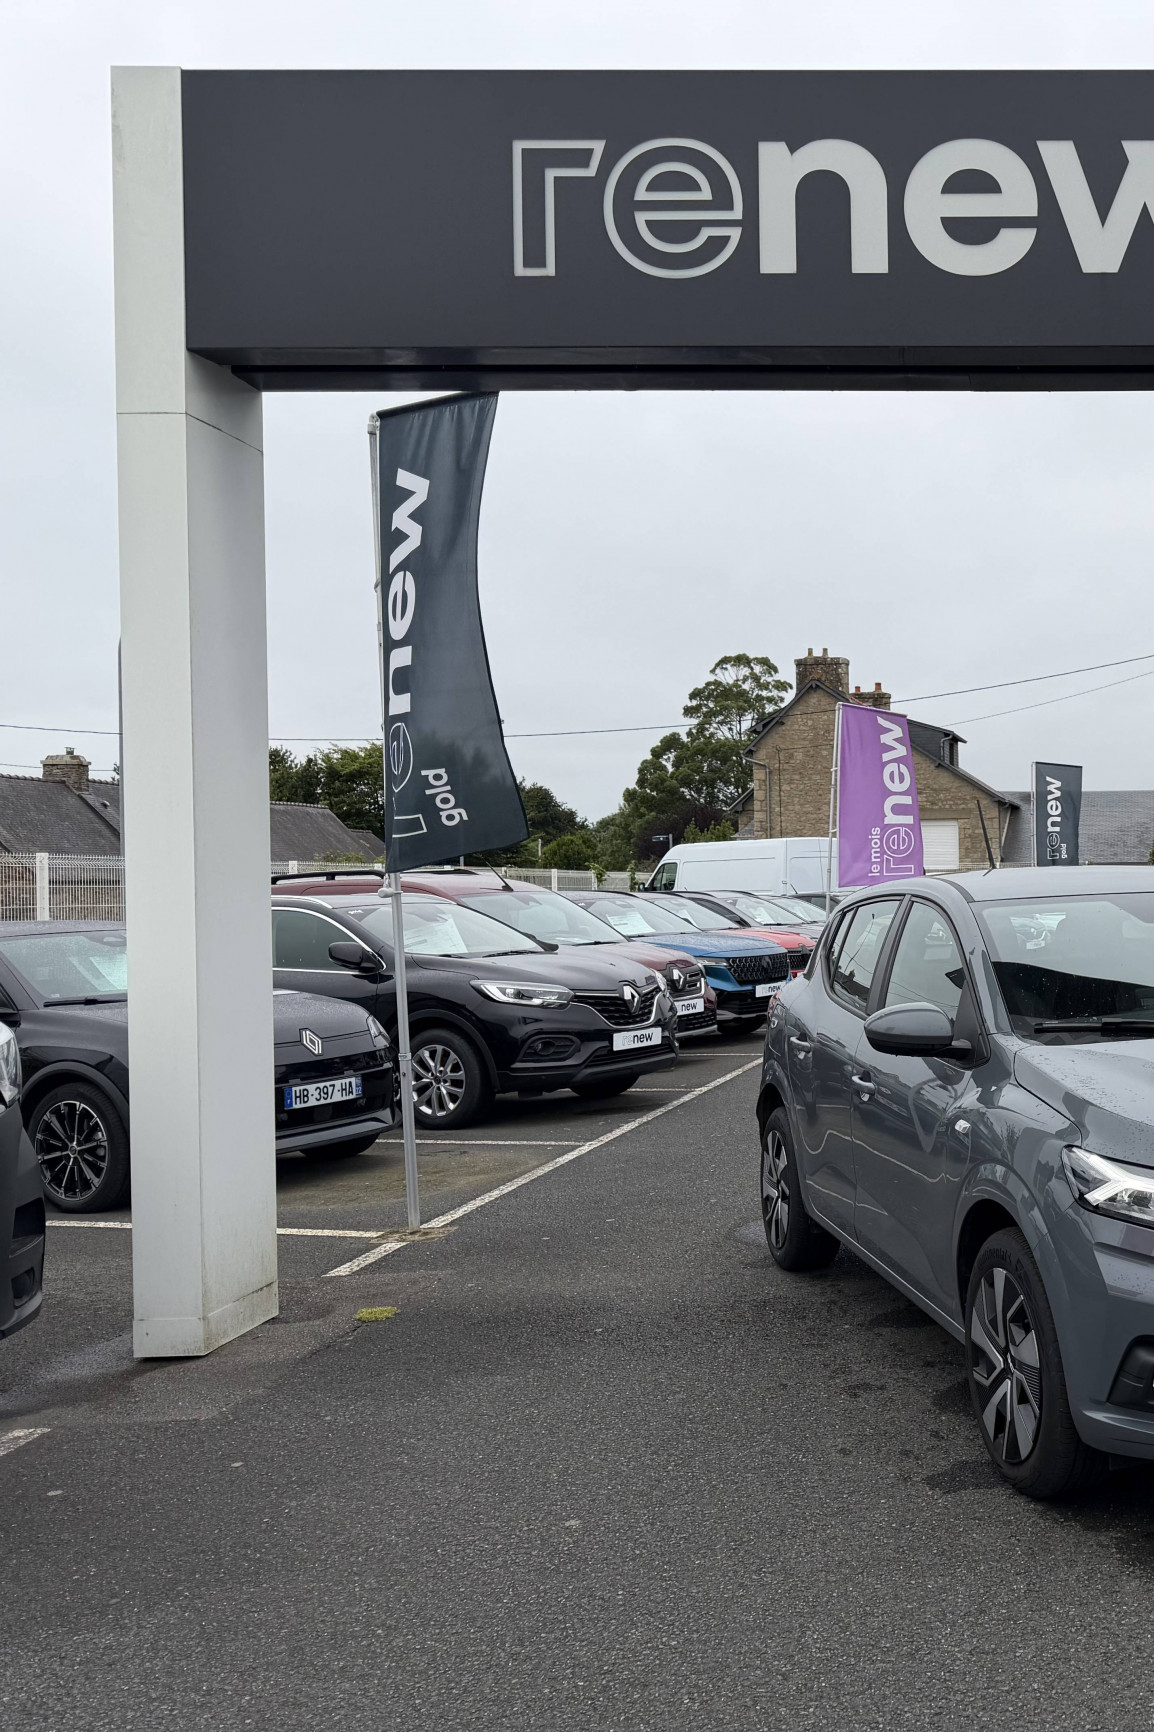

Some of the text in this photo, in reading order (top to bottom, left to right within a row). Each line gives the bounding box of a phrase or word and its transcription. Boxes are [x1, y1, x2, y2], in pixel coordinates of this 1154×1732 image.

[421, 767, 469, 827] gold
[876, 716, 915, 876] renew
[1045, 776, 1062, 860] renew
[868, 827, 881, 876] le mois
[294, 1080, 354, 1105] HB-397-HA
